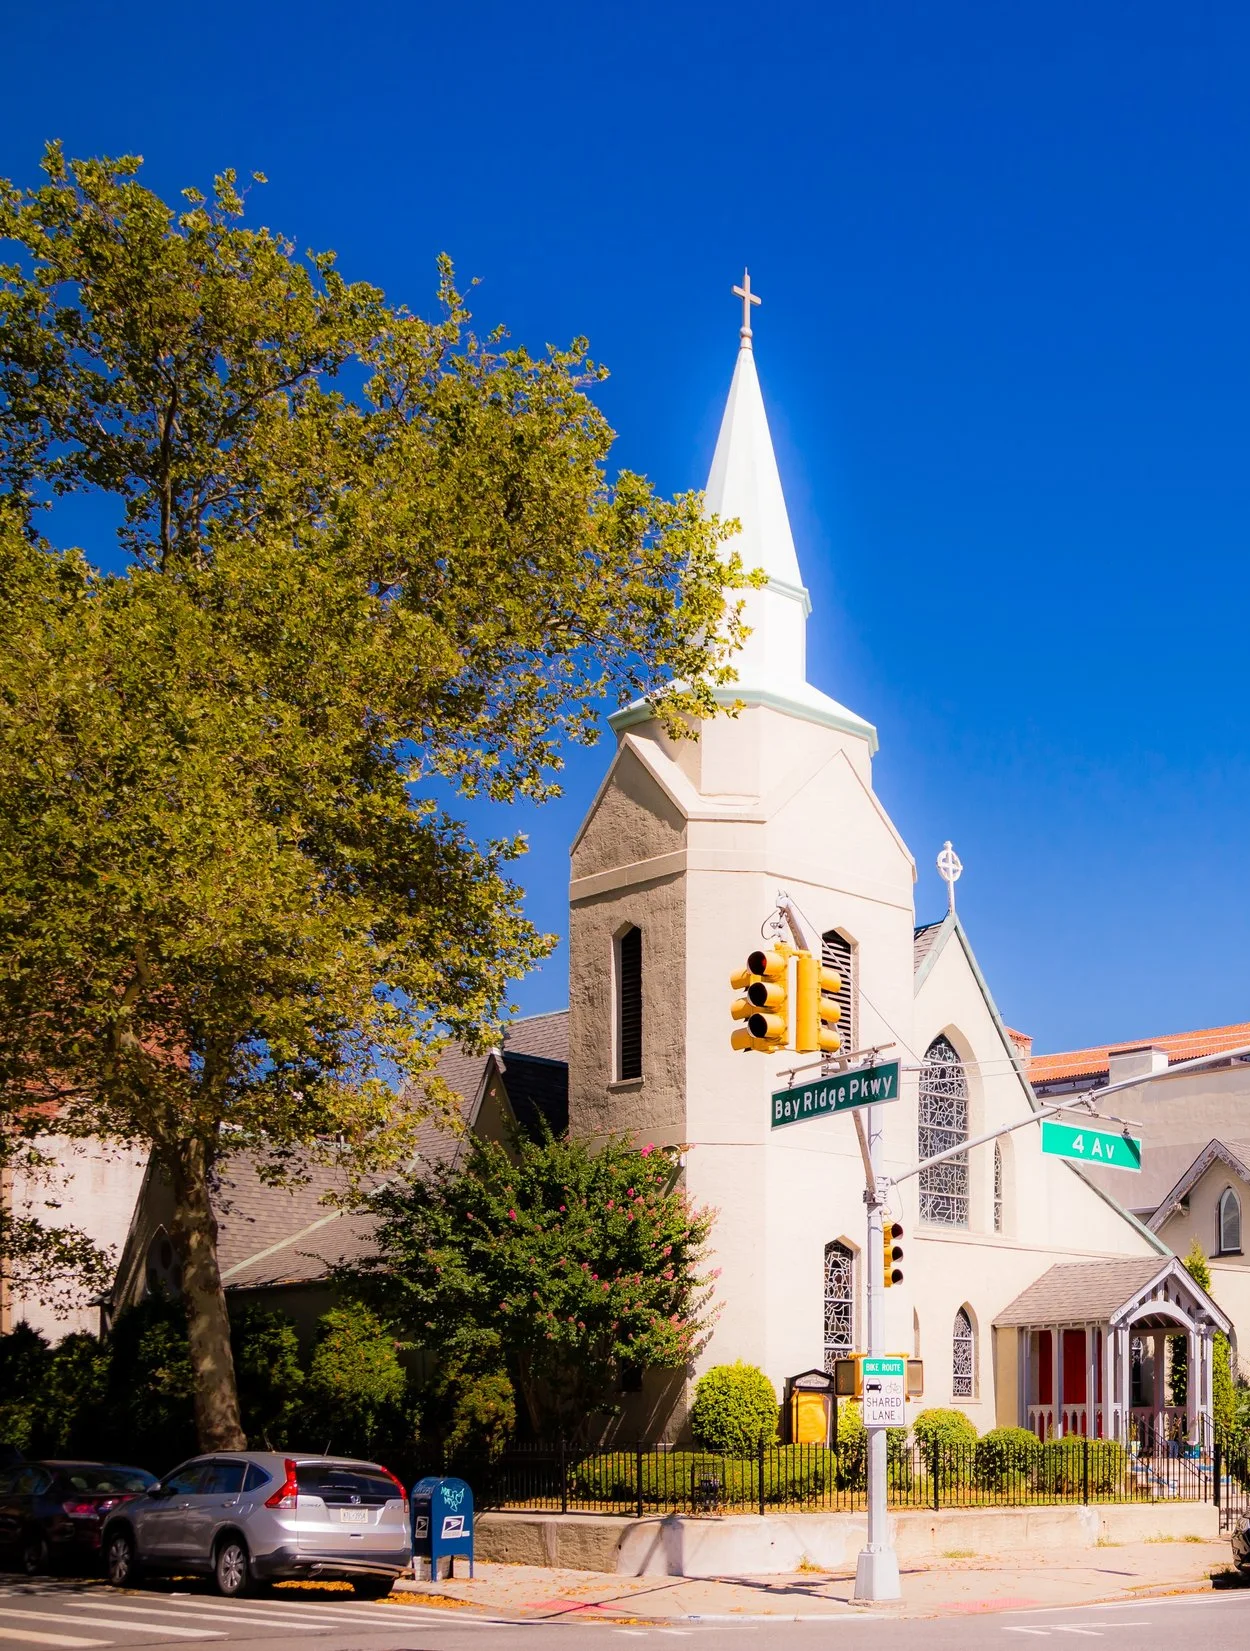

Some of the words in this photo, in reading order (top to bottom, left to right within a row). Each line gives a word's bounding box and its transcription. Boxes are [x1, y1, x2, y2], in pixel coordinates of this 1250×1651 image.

[775, 1099, 800, 1119] Bay
[803, 1086, 846, 1111] Ridge
[849, 1075, 893, 1100] Pkwy
[1072, 1134, 1085, 1153] 4
[1091, 1137, 1115, 1159] Av
[865, 1363, 879, 1372] BIKE
[881, 1363, 901, 1372] ROUTE
[866, 1397, 902, 1407] SHARED
[872, 1410, 896, 1420] LANE
